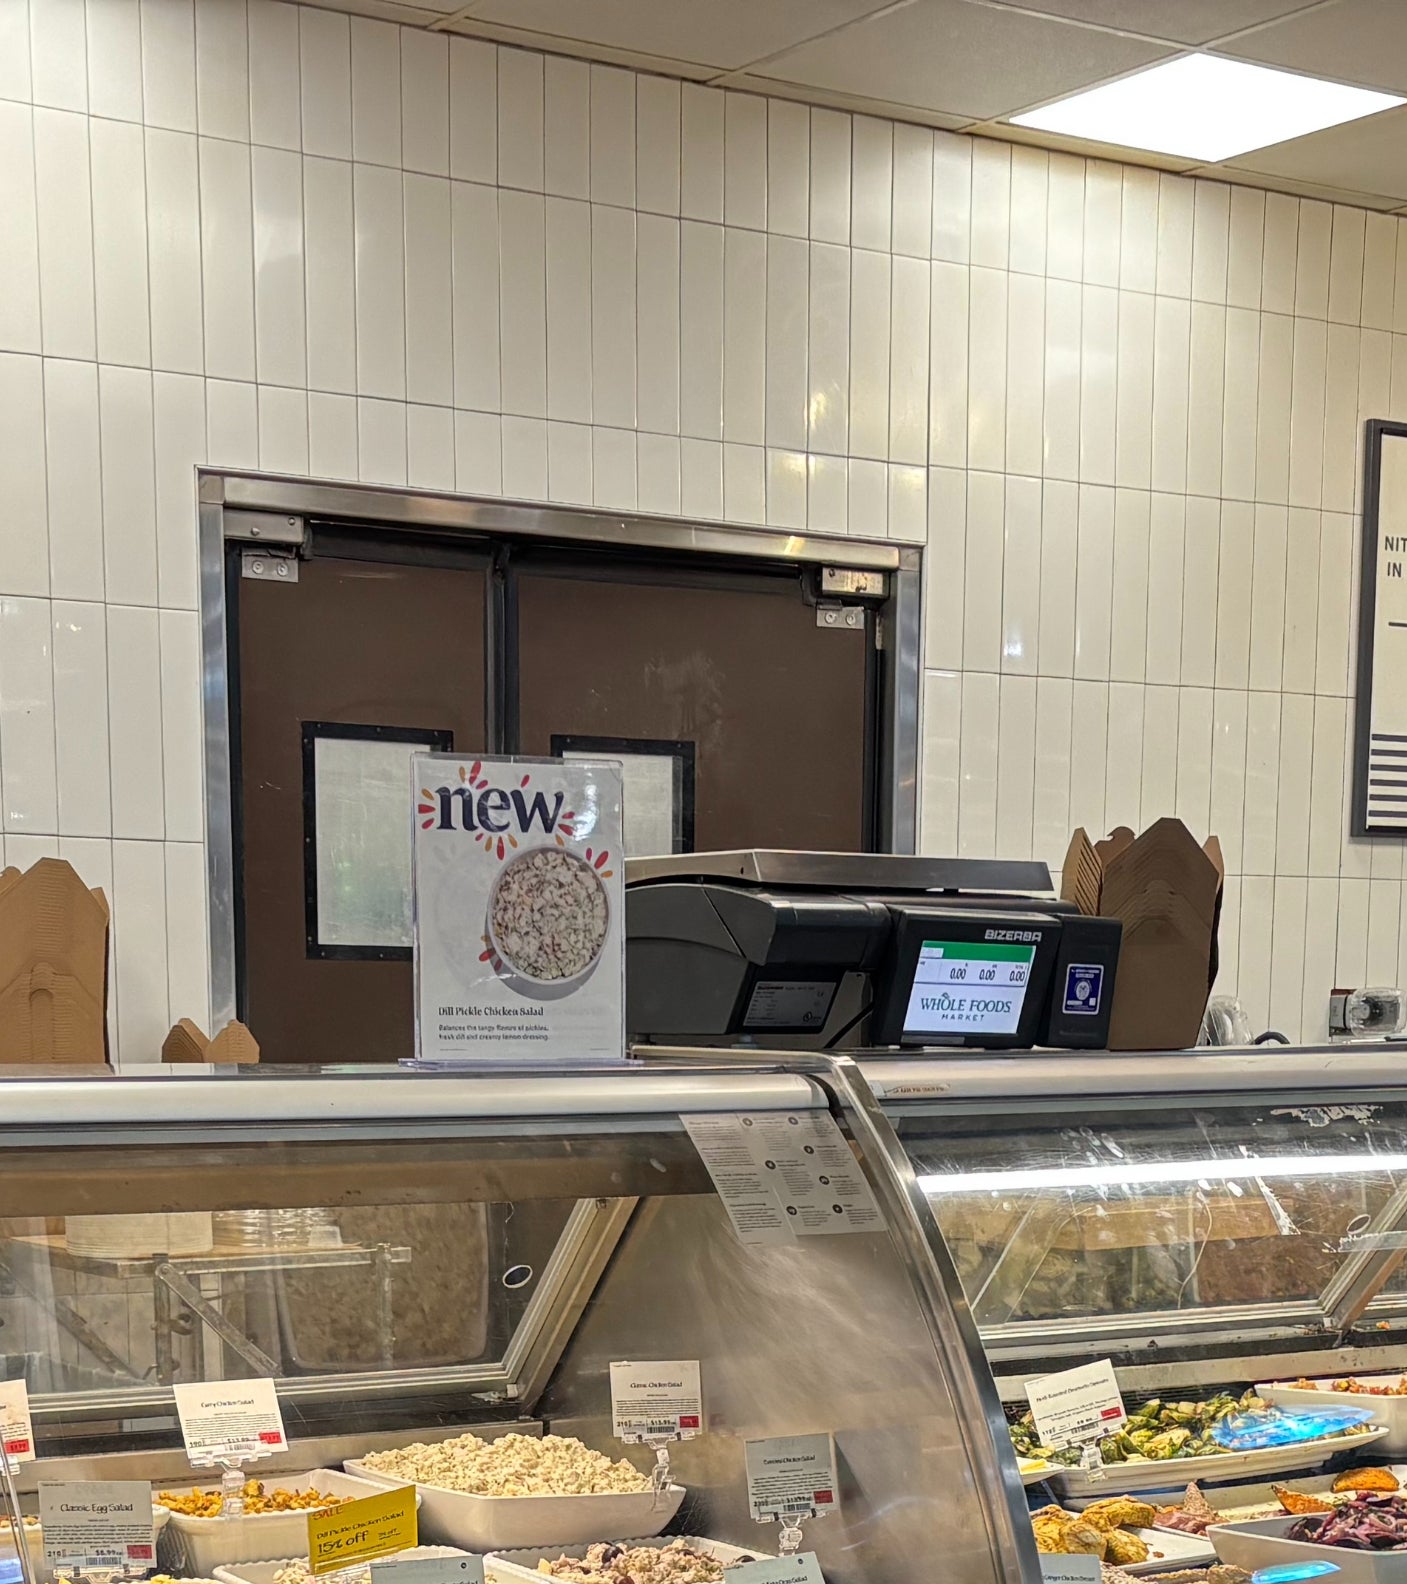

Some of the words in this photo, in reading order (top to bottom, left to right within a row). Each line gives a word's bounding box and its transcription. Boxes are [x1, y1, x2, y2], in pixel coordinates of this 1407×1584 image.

[1387, 563, 1402, 578] IN
[435, 785, 564, 834] new
[985, 929, 1042, 942] BIZERBA
[950, 968, 966, 980] 0.00
[979, 969, 995, 981] 0.00
[1009, 970, 1026, 982] 0.00
[921, 993, 965, 1011] WHOLE
[970, 1000, 1012, 1014] FOODS
[439, 1007, 453, 1016] Dill
[455, 1007, 482, 1016] Pickle
[484, 1007, 518, 1016] Chicken
[520, 1007, 544, 1016] Salad
[942, 1013, 985, 1022] MARKET
[61, 1503, 90, 1512] Classic
[92, 1504, 108, 1513] Egg
[109, 1503, 133, 1511] Salad
[312, 1506, 343, 1520] SALE
[346, 1530, 369, 1546] off
